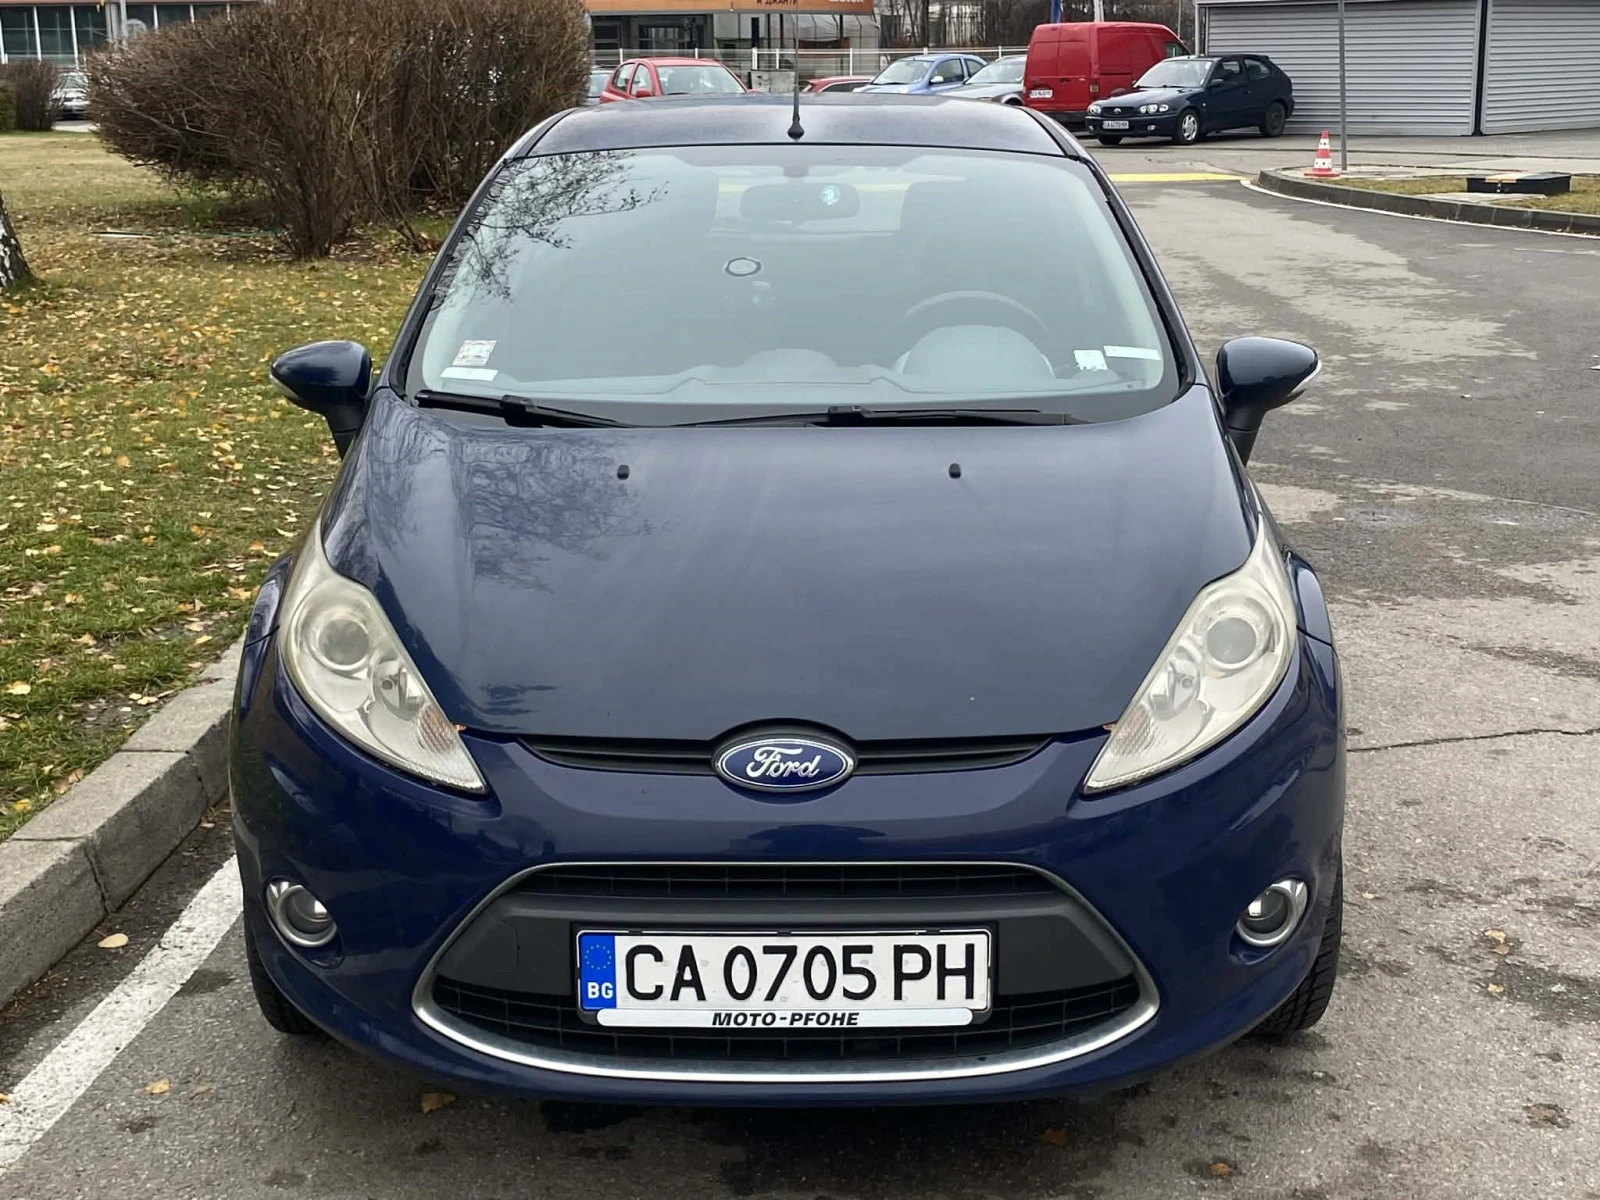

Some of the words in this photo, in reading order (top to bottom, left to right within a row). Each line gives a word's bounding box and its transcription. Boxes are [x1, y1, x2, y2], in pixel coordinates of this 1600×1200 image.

[746, 747, 822, 778] Ford
[625, 945, 706, 1001] CA
[723, 945, 877, 1001] 0705
[893, 944, 975, 1001] PH
[587, 981, 614, 998] BG
[712, 1012, 860, 1026] MOTO-PFOHE
